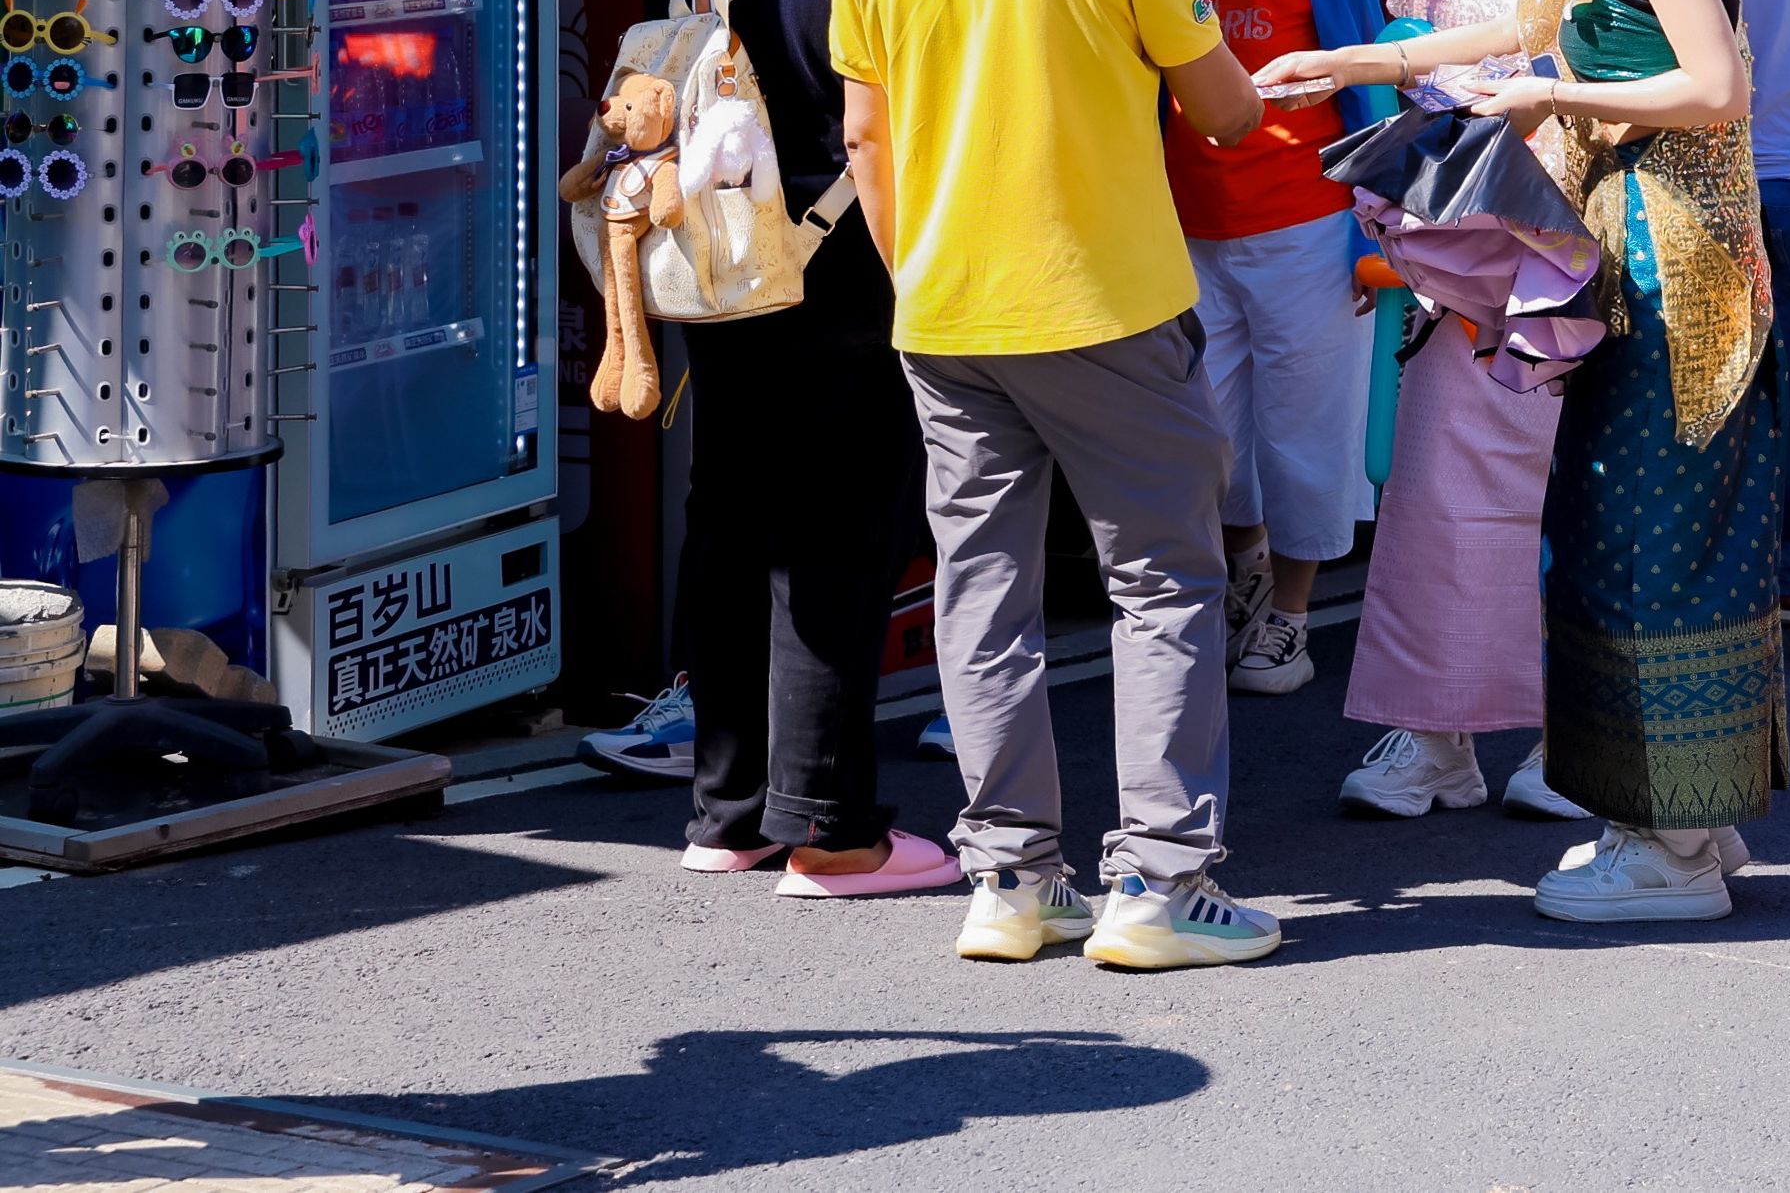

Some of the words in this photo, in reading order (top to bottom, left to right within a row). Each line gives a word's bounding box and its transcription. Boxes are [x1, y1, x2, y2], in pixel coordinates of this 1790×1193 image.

[1221, 4, 1273, 42] RIS
[328, 562, 452, 650] 百岁山
[333, 596, 547, 713] 真正天然矿泉水
